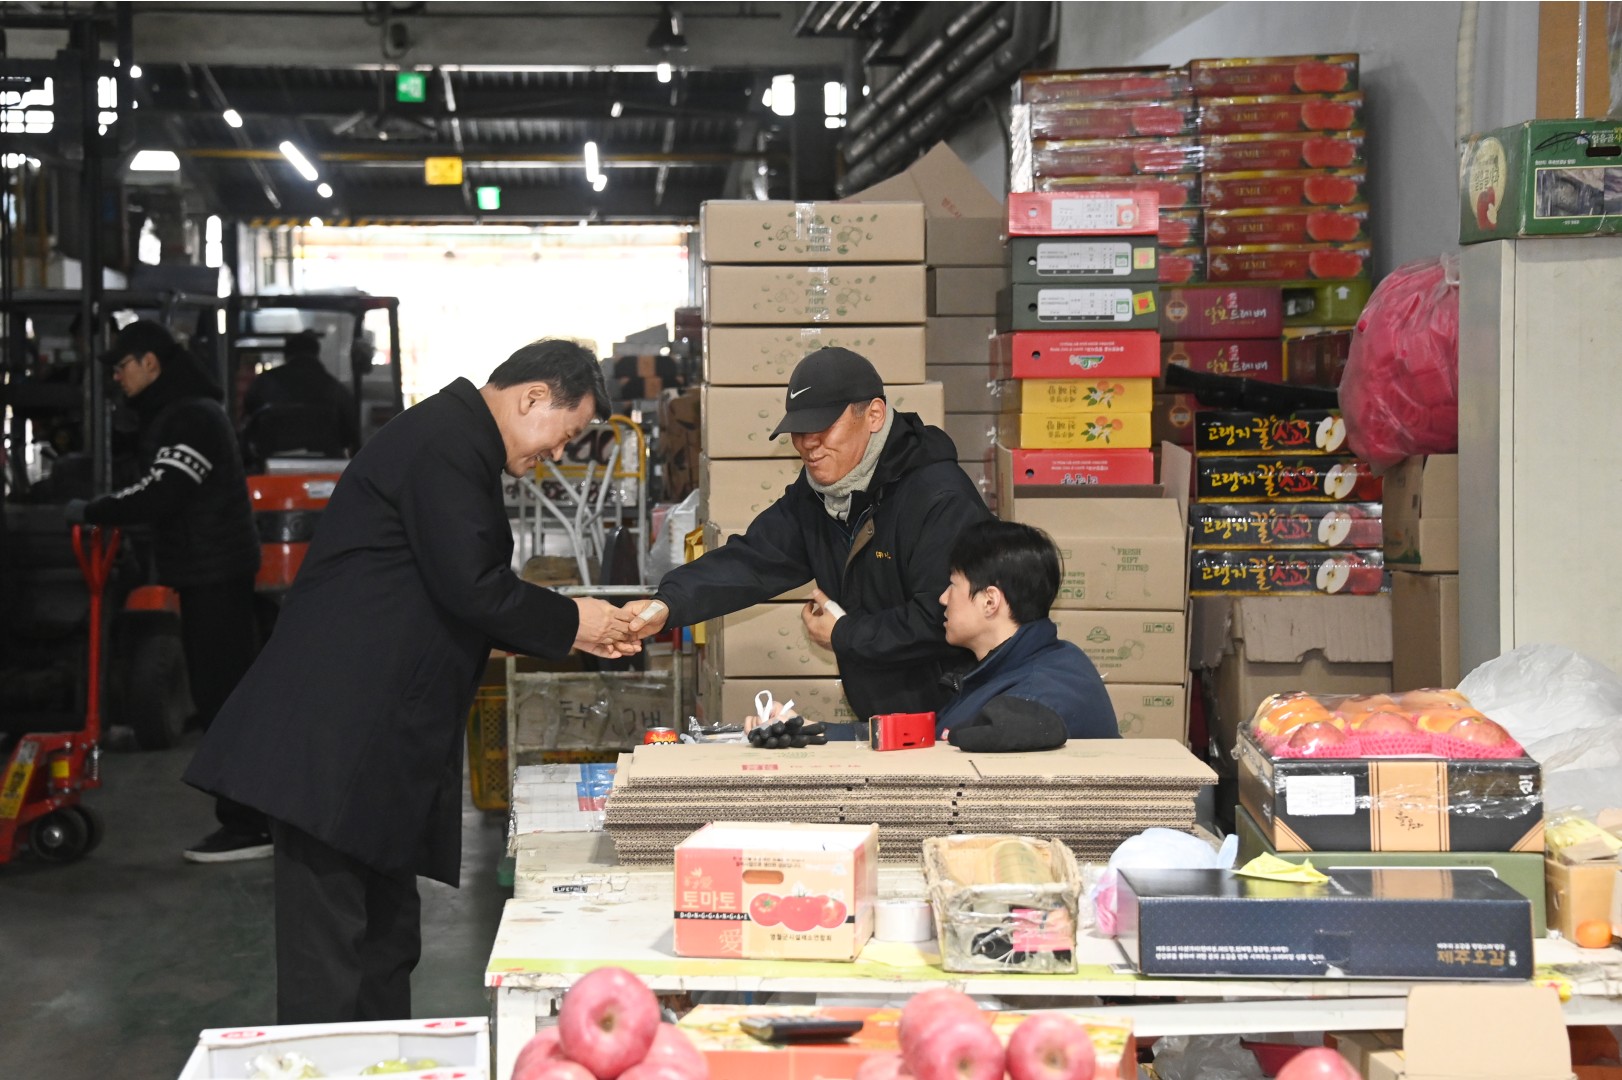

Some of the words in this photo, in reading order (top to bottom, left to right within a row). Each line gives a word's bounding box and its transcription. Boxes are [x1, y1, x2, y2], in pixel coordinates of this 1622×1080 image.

[1208, 425, 1250, 446] 고랭지
[1210, 471, 1255, 492] 고랭지
[1203, 518, 1249, 540] 고랭지
[1117, 548, 1142, 556] FRESH
[1121, 556, 1139, 564] GIFT
[1202, 565, 1247, 586] 고랭지
[681, 890, 737, 912] 토마토
